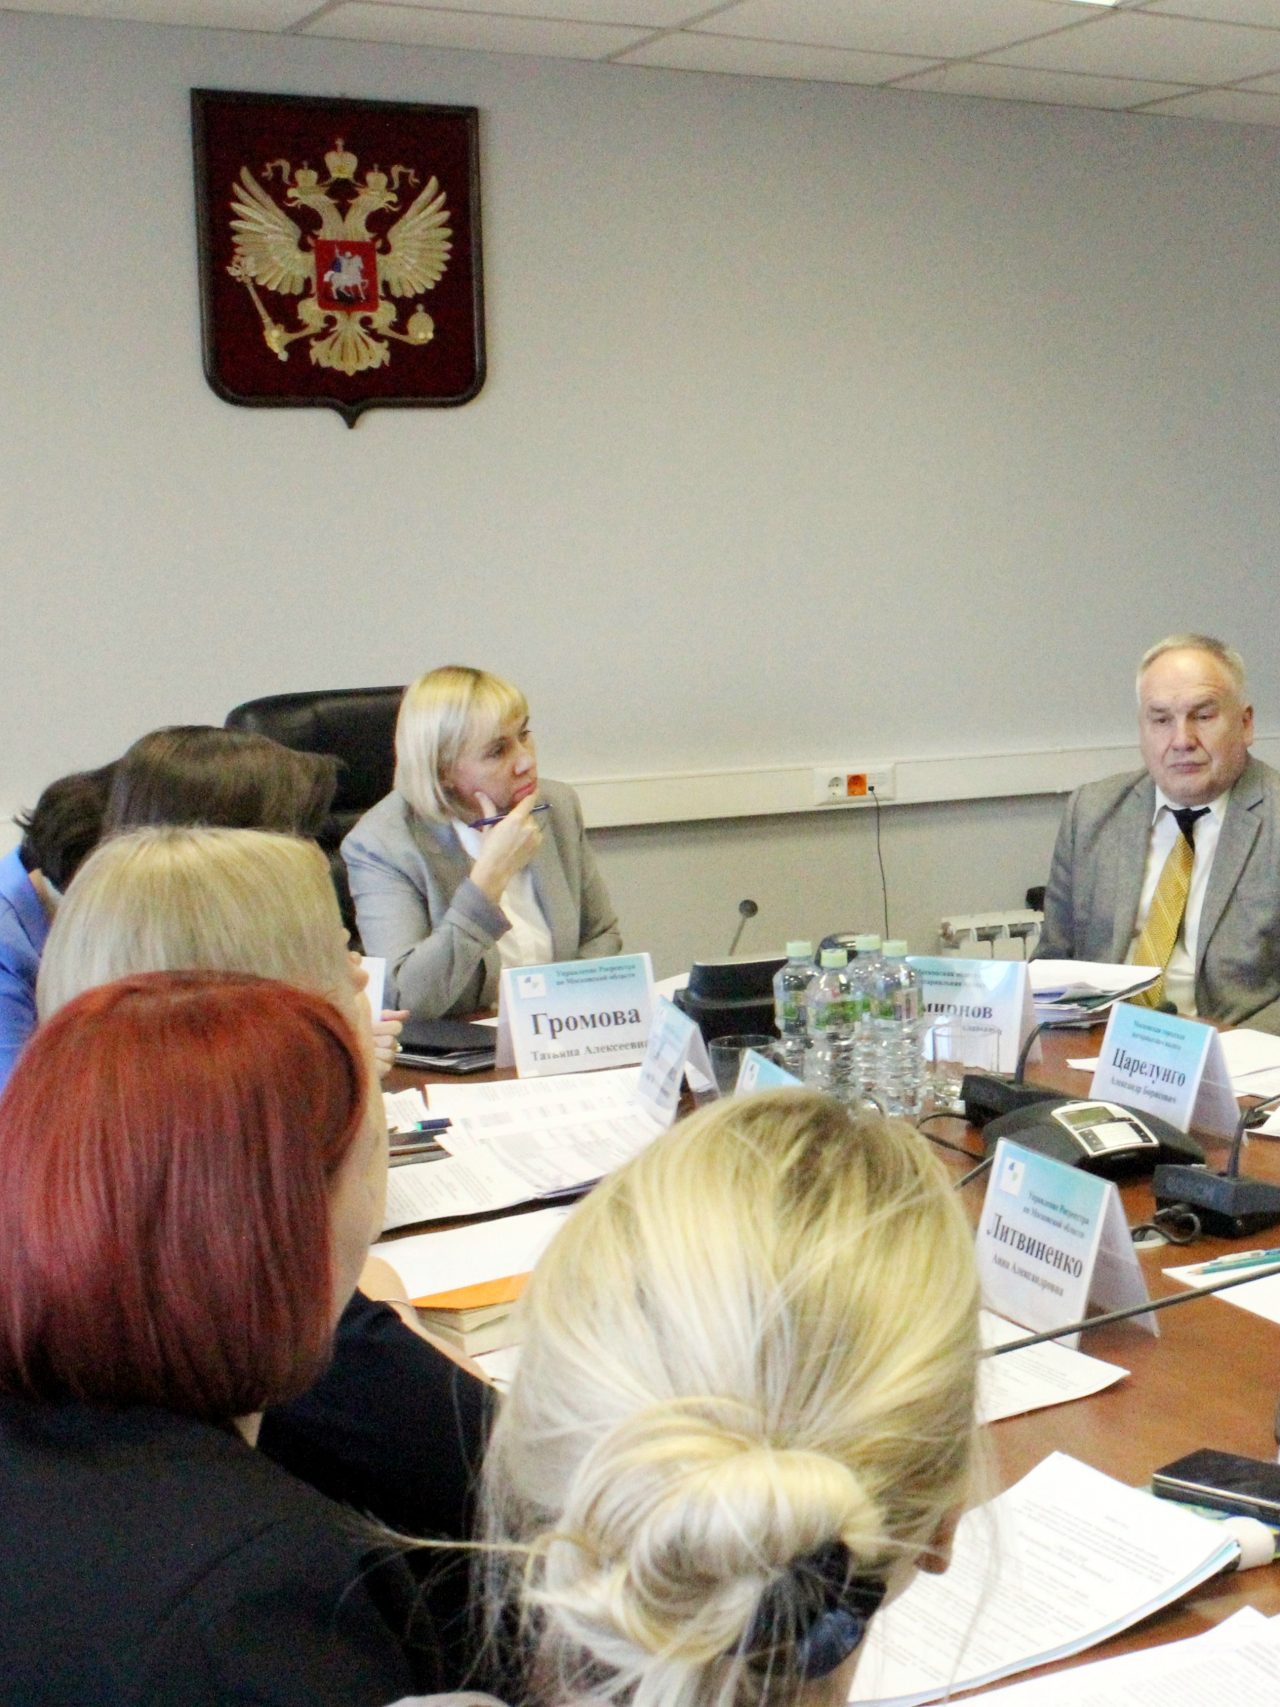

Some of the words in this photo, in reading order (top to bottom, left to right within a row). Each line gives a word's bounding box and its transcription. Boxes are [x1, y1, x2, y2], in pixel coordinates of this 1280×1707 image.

[531, 1008, 641, 1040] Громова
[530, 1048, 580, 1062] Татьяна
[1112, 1048, 1186, 1087] Царелунго
[986, 1212, 1083, 1279] Литвиненко
